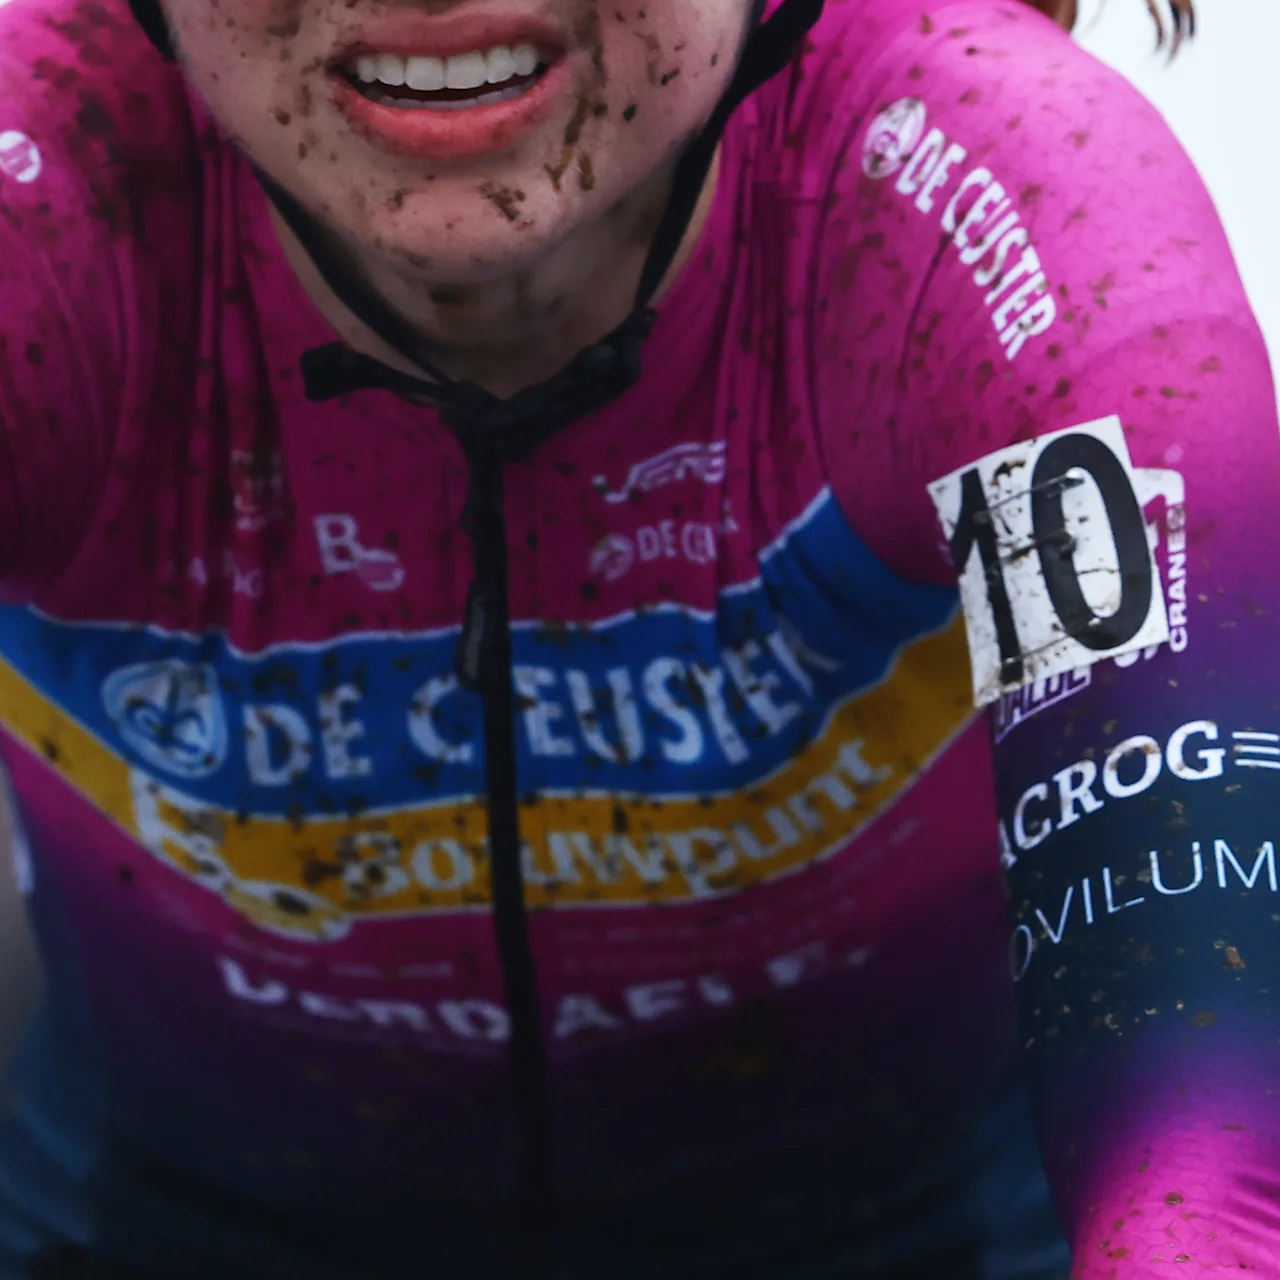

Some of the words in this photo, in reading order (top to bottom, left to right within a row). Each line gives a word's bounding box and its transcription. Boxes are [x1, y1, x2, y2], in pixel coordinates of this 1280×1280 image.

[894, 126, 967, 215] DE
[939, 165, 1058, 361] CEUSTER
[951, 431, 1154, 686] 10
[242, 682, 374, 787] DE
[338, 736, 894, 898] Bouwpunt
